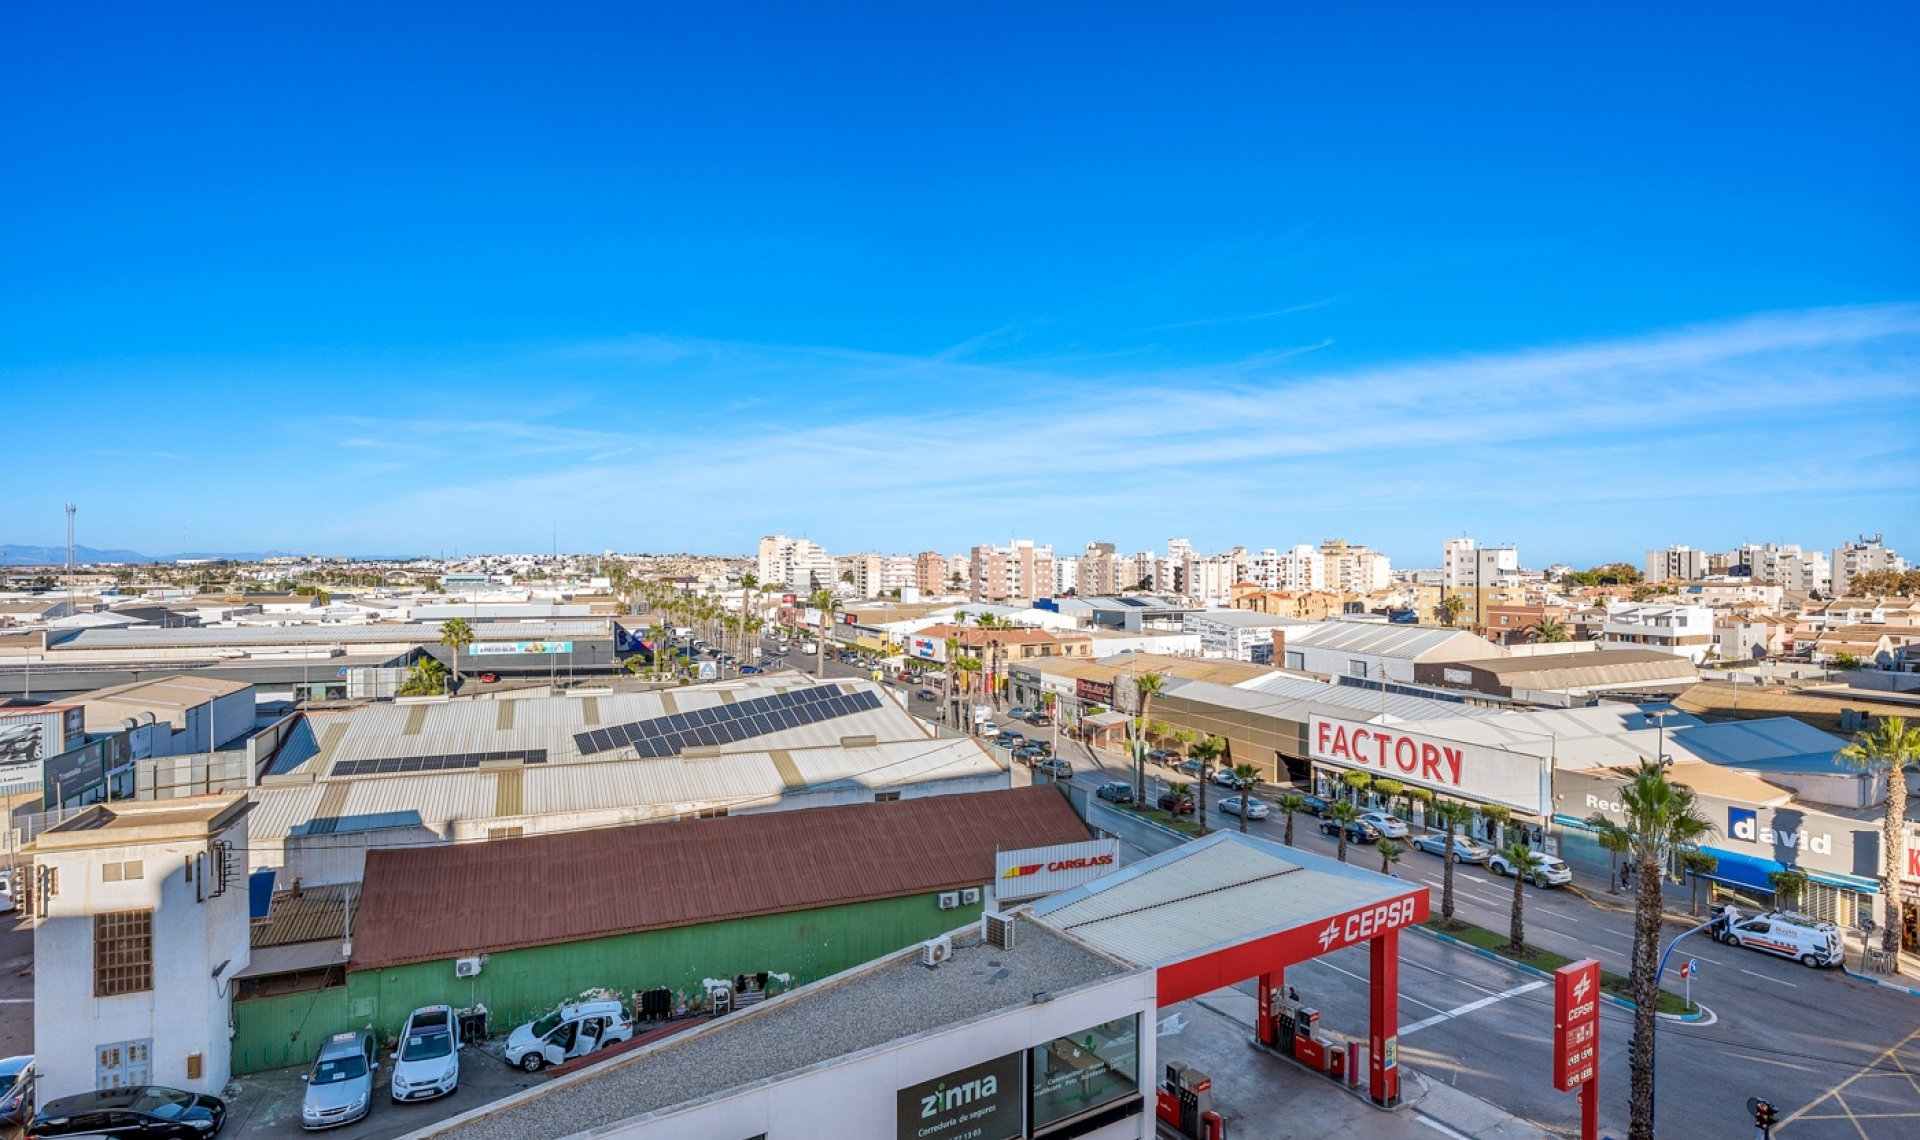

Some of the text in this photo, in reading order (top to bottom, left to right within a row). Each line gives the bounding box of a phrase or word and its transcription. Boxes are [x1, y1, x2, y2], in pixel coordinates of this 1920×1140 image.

[1318, 721, 1463, 786] FACTORY
[1734, 817, 1832, 855] david
[1048, 855, 1113, 872] CARGLASS
[1344, 897, 1415, 942] CEPSA
[1568, 1001, 1594, 1021] CEPSA
[969, 1105, 997, 1119] seguros
